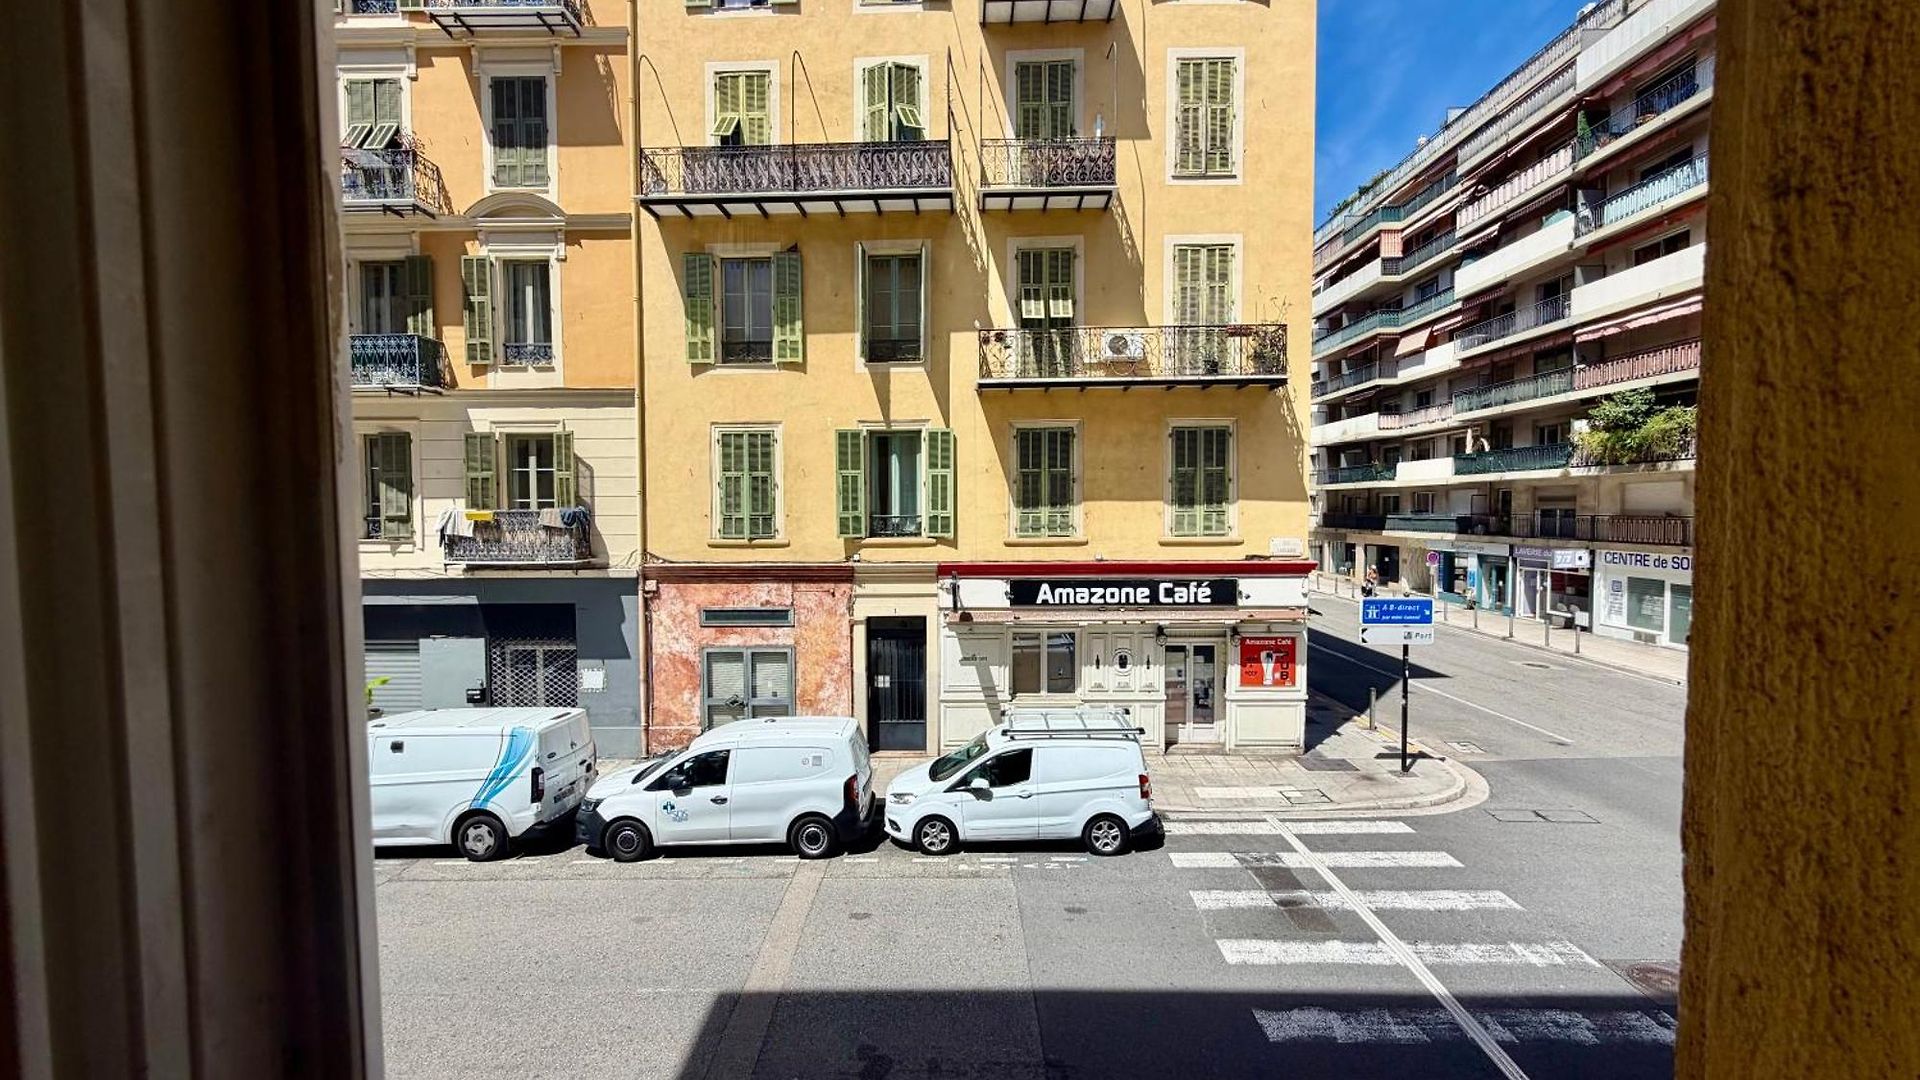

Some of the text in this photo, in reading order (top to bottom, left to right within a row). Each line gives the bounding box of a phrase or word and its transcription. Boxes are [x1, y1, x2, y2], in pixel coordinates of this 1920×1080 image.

[1605, 551, 1694, 571] CENTRE de SO
[1036, 582, 1211, 604] Amazone Café
[1415, 632, 1432, 640] Port
